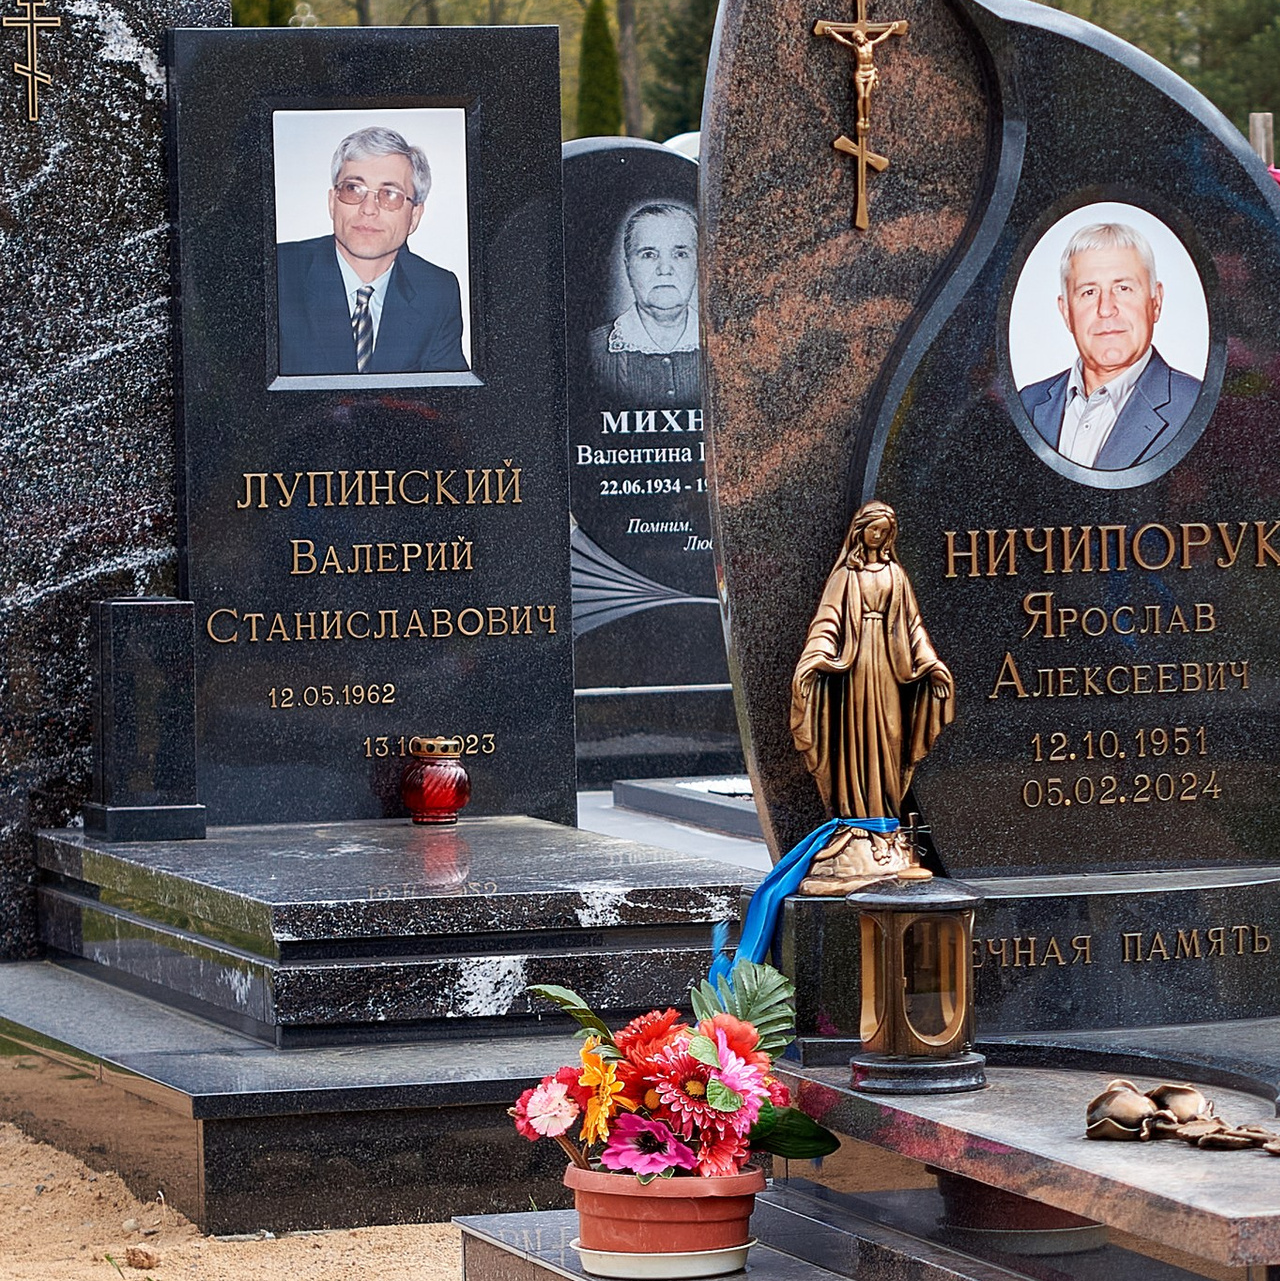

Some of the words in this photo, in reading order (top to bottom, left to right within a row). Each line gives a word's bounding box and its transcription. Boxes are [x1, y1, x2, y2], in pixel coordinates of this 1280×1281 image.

[576, 445, 693, 465] Валентина
[237, 459, 523, 509] ЛУПИНСКИЙ
[600, 478, 681, 495] 22.06.1934
[626, 519, 693, 534] Помним.
[268, 683, 396, 709] 12.05.1962
[1030, 726, 1208, 763] 12.10.1951
[1022, 770, 1223, 809] 05.02.2024
[930, 928, 1092, 969] ЕЧНАЯ
[1122, 924, 1272, 964] ПАМЯТЬ
